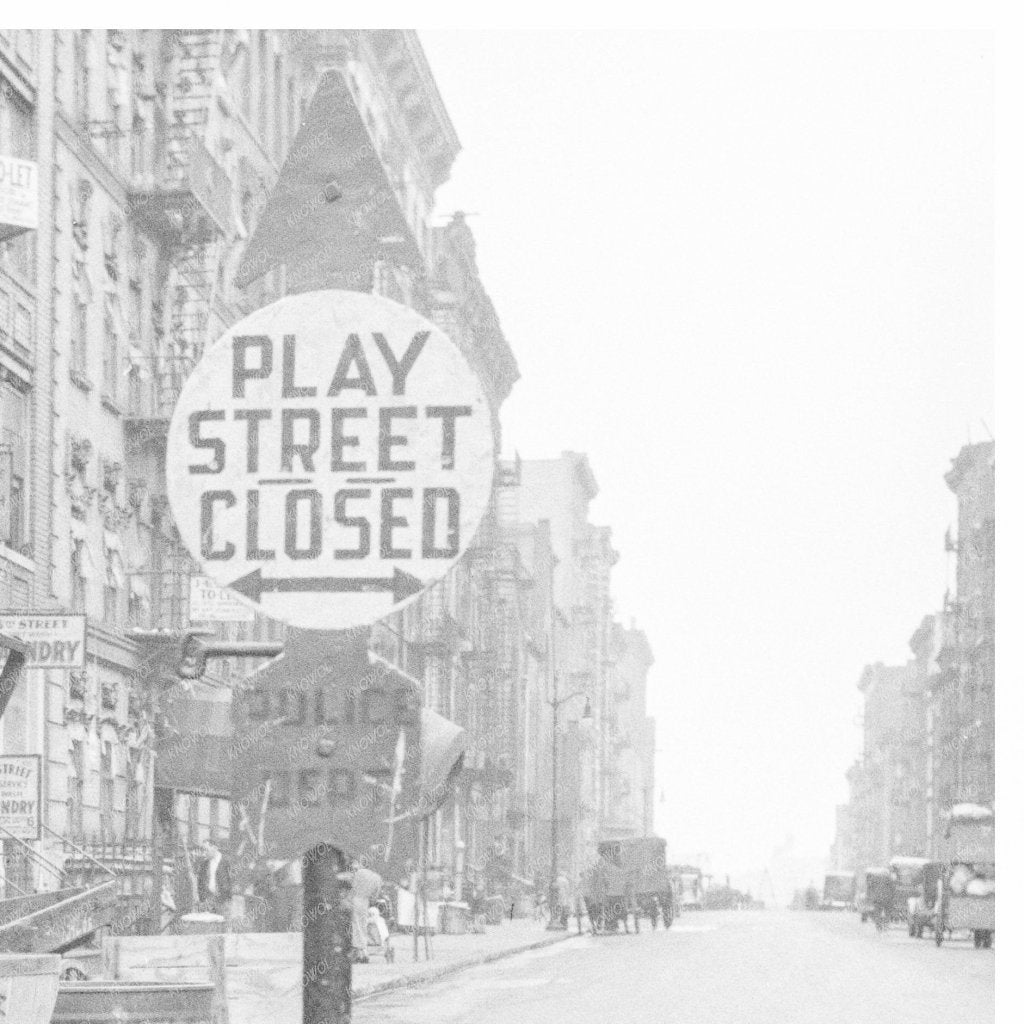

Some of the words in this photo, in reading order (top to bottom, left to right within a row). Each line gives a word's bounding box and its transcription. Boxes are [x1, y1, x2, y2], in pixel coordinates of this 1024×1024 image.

[232, 330, 431, 399] PLAY
[187, 405, 472, 475] STREET
[200, 487, 460, 561] CLOSED
[18, 619, 68, 630] STREET
[243, 686, 418, 727] POLICE
